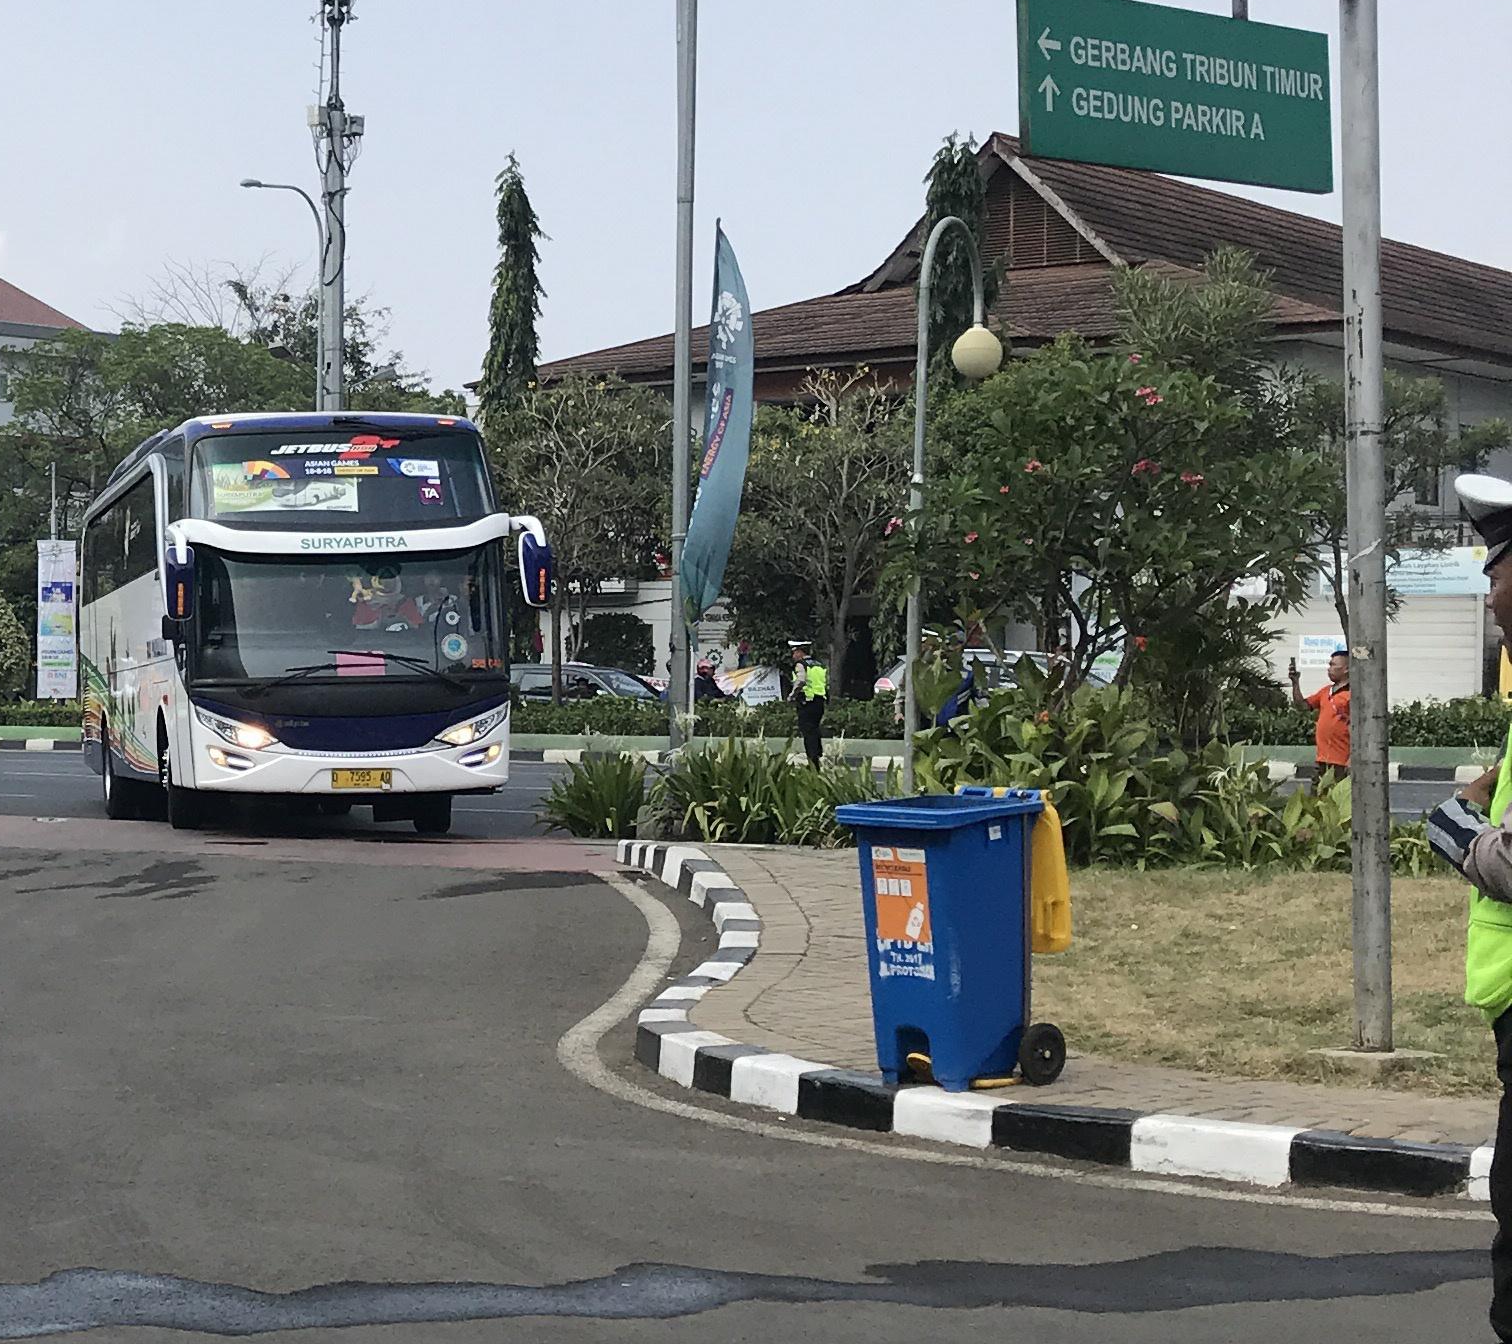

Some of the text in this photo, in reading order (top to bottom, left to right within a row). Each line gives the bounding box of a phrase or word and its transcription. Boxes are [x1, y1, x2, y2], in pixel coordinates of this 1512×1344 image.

[1070, 36, 1323, 101] GERBANG TRIBUN TIMUR
[1072, 87, 1265, 141] GEDUNG PARKIR A
[270, 443, 353, 455] JETBUS
[421, 487, 440, 499] TA
[301, 536, 408, 549] SURYAPUTRA
